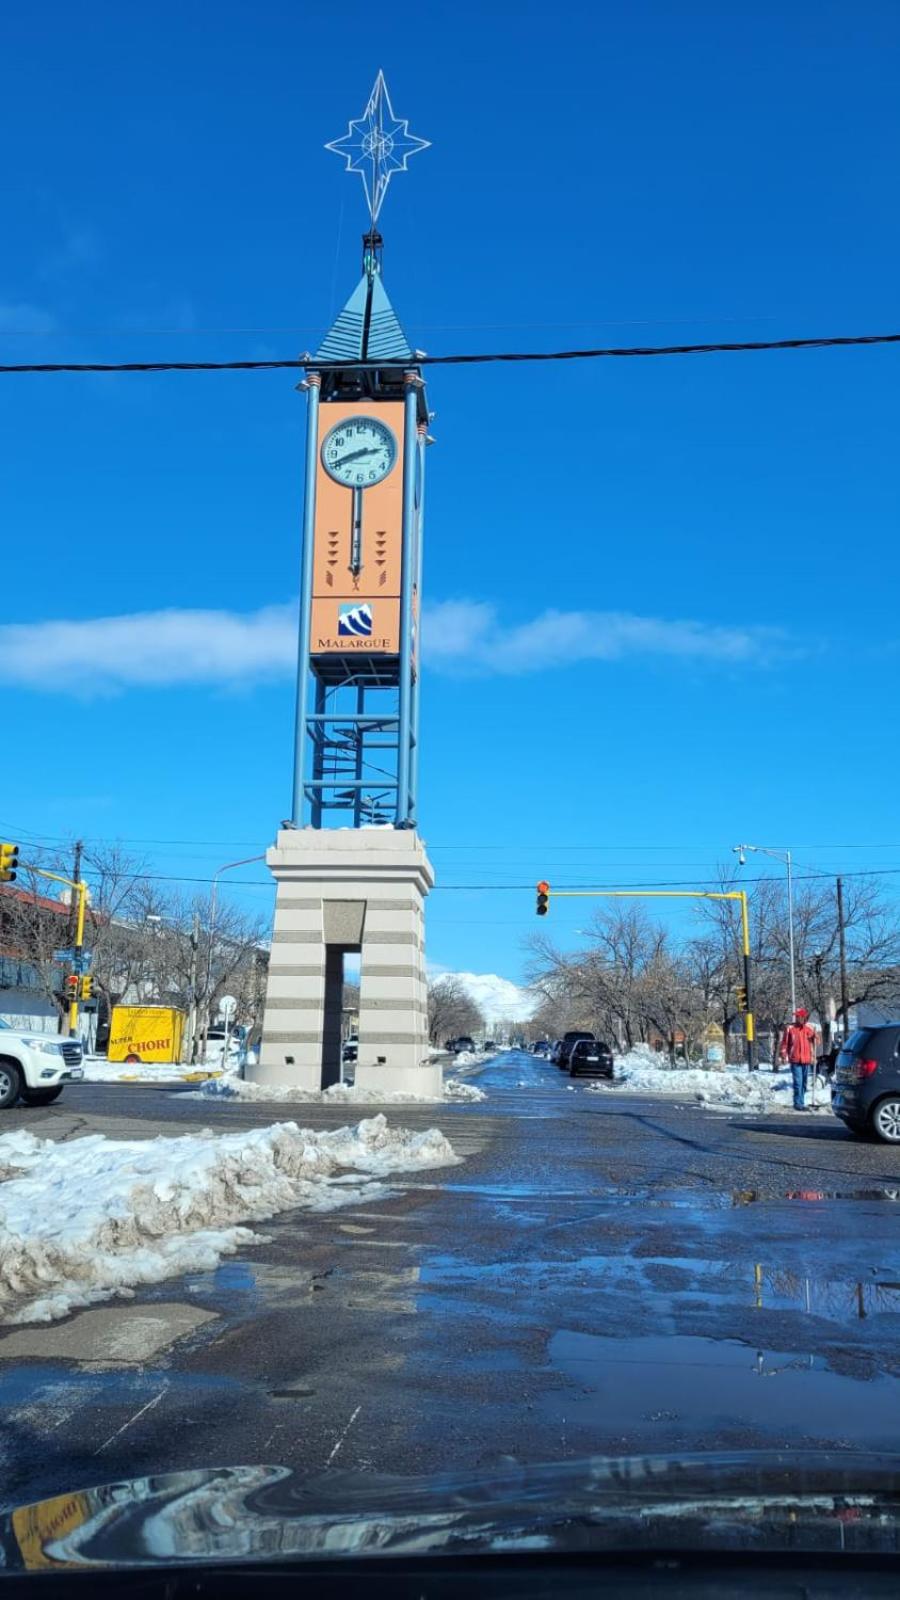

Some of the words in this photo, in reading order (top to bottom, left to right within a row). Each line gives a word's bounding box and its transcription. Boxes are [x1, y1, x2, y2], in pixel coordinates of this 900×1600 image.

[346, 429, 353, 438] 11
[356, 425, 366, 434] 12
[335, 437, 345, 446] 10
[331, 450, 338, 458] 9
[384, 448, 392, 458] 3
[379, 462, 386, 470] 4
[345, 470, 352, 479] 7
[356, 474, 364, 482] 6
[128, 1038, 171, 1054] CHORI
